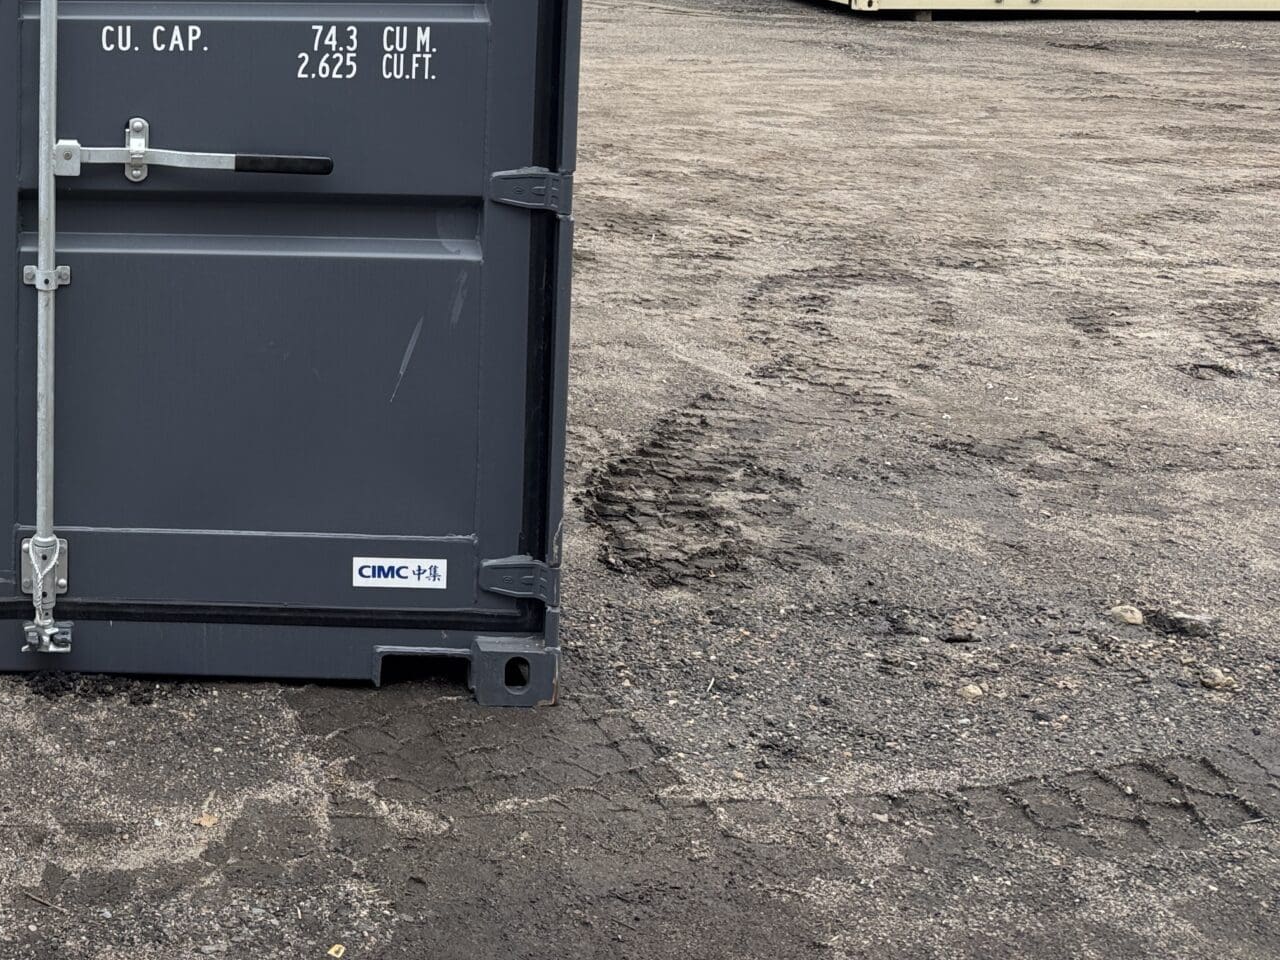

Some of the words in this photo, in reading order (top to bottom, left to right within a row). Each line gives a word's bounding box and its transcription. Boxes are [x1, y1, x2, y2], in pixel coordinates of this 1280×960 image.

[101, 25, 139, 51] CU.
[152, 25, 208, 51] CAP.
[312, 25, 358, 51] 74.3
[358, 565, 408, 579] CIMC
[412, 565, 442, 582] 中集
